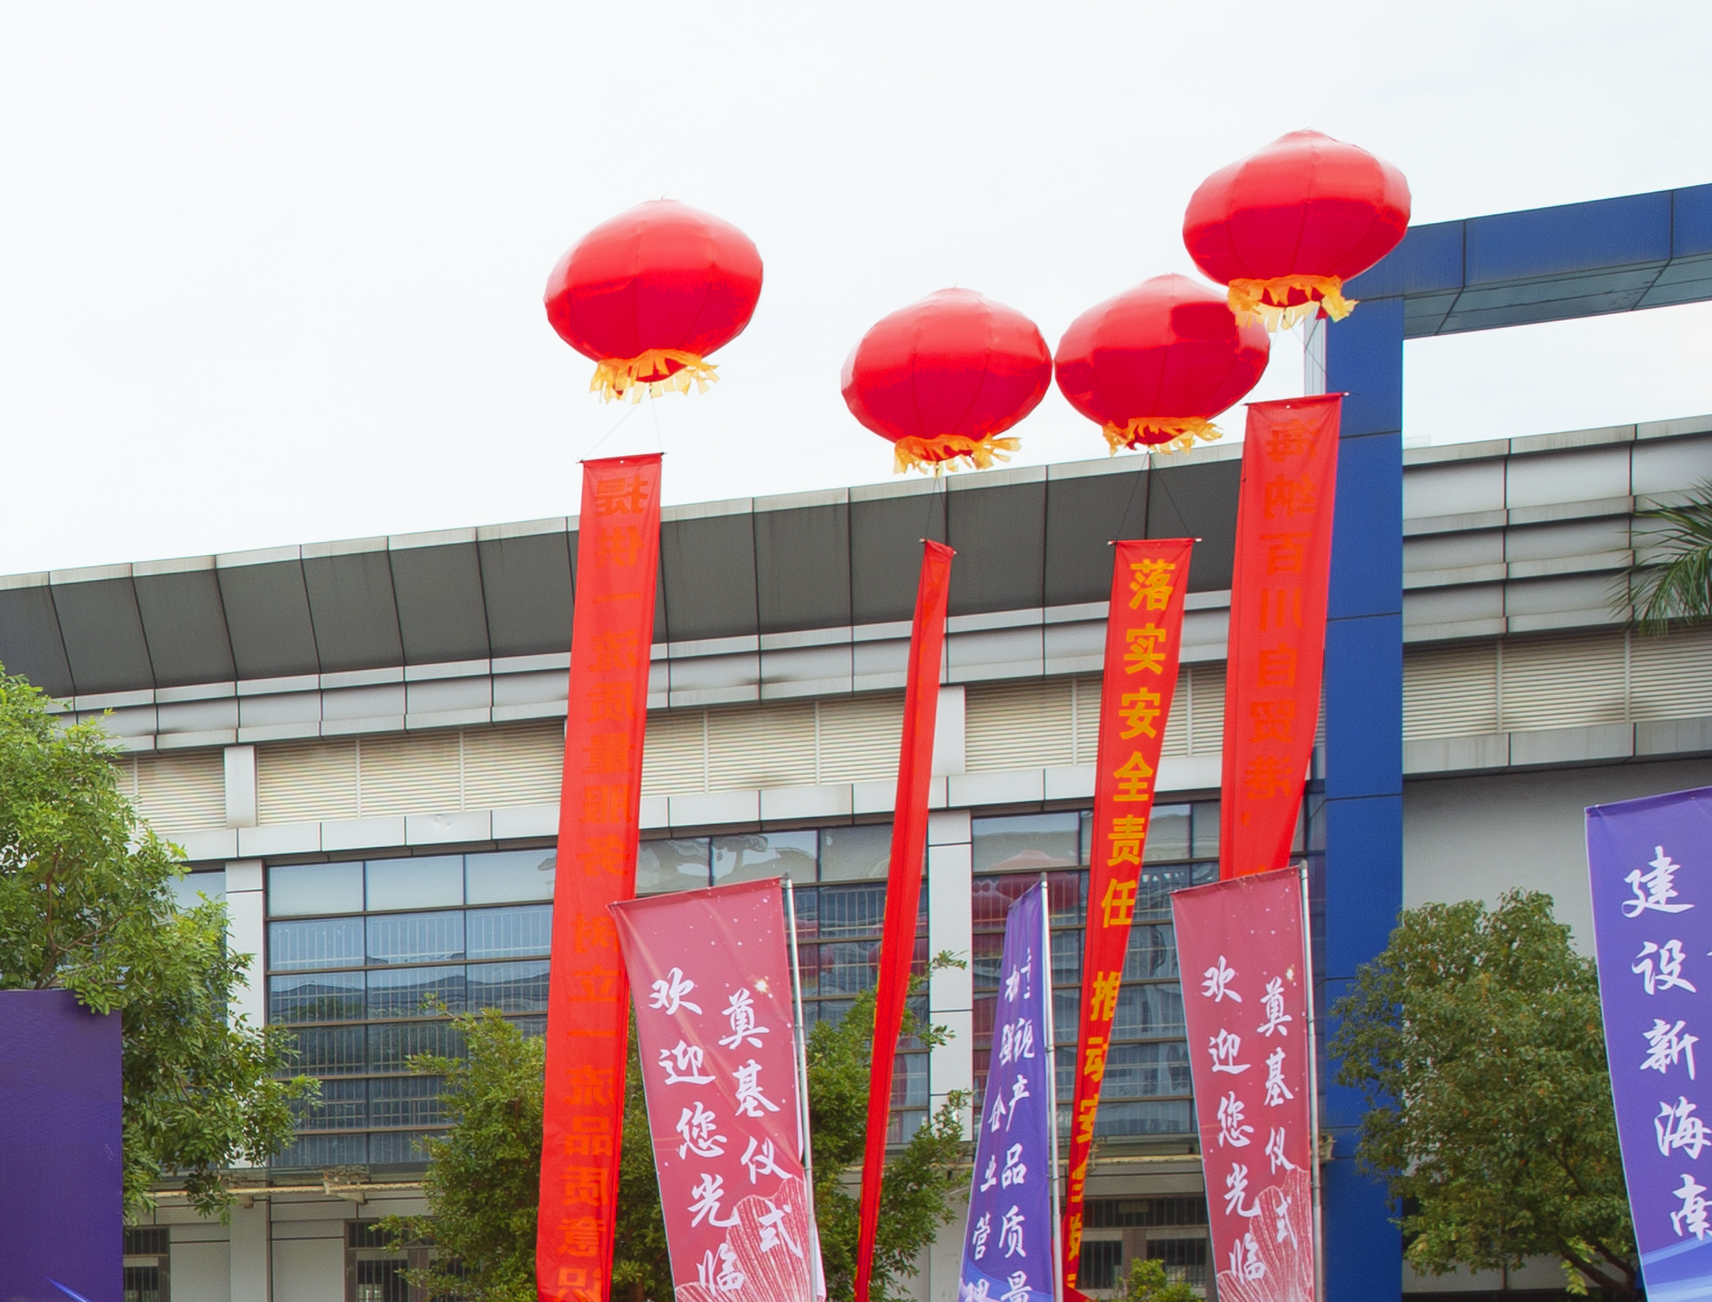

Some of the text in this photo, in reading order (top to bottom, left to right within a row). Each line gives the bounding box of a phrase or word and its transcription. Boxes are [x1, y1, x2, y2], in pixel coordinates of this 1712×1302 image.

[1100, 559, 1176, 928] 落实安全责任
[648, 966, 746, 1296] 欢迎您光临
[718, 986, 804, 1258] 奠基仪式
[1200, 955, 1267, 1285] 欢迎您光临
[1257, 976, 1299, 1251] 奠基仪式
[1621, 845, 1712, 1242] 建设新海南
